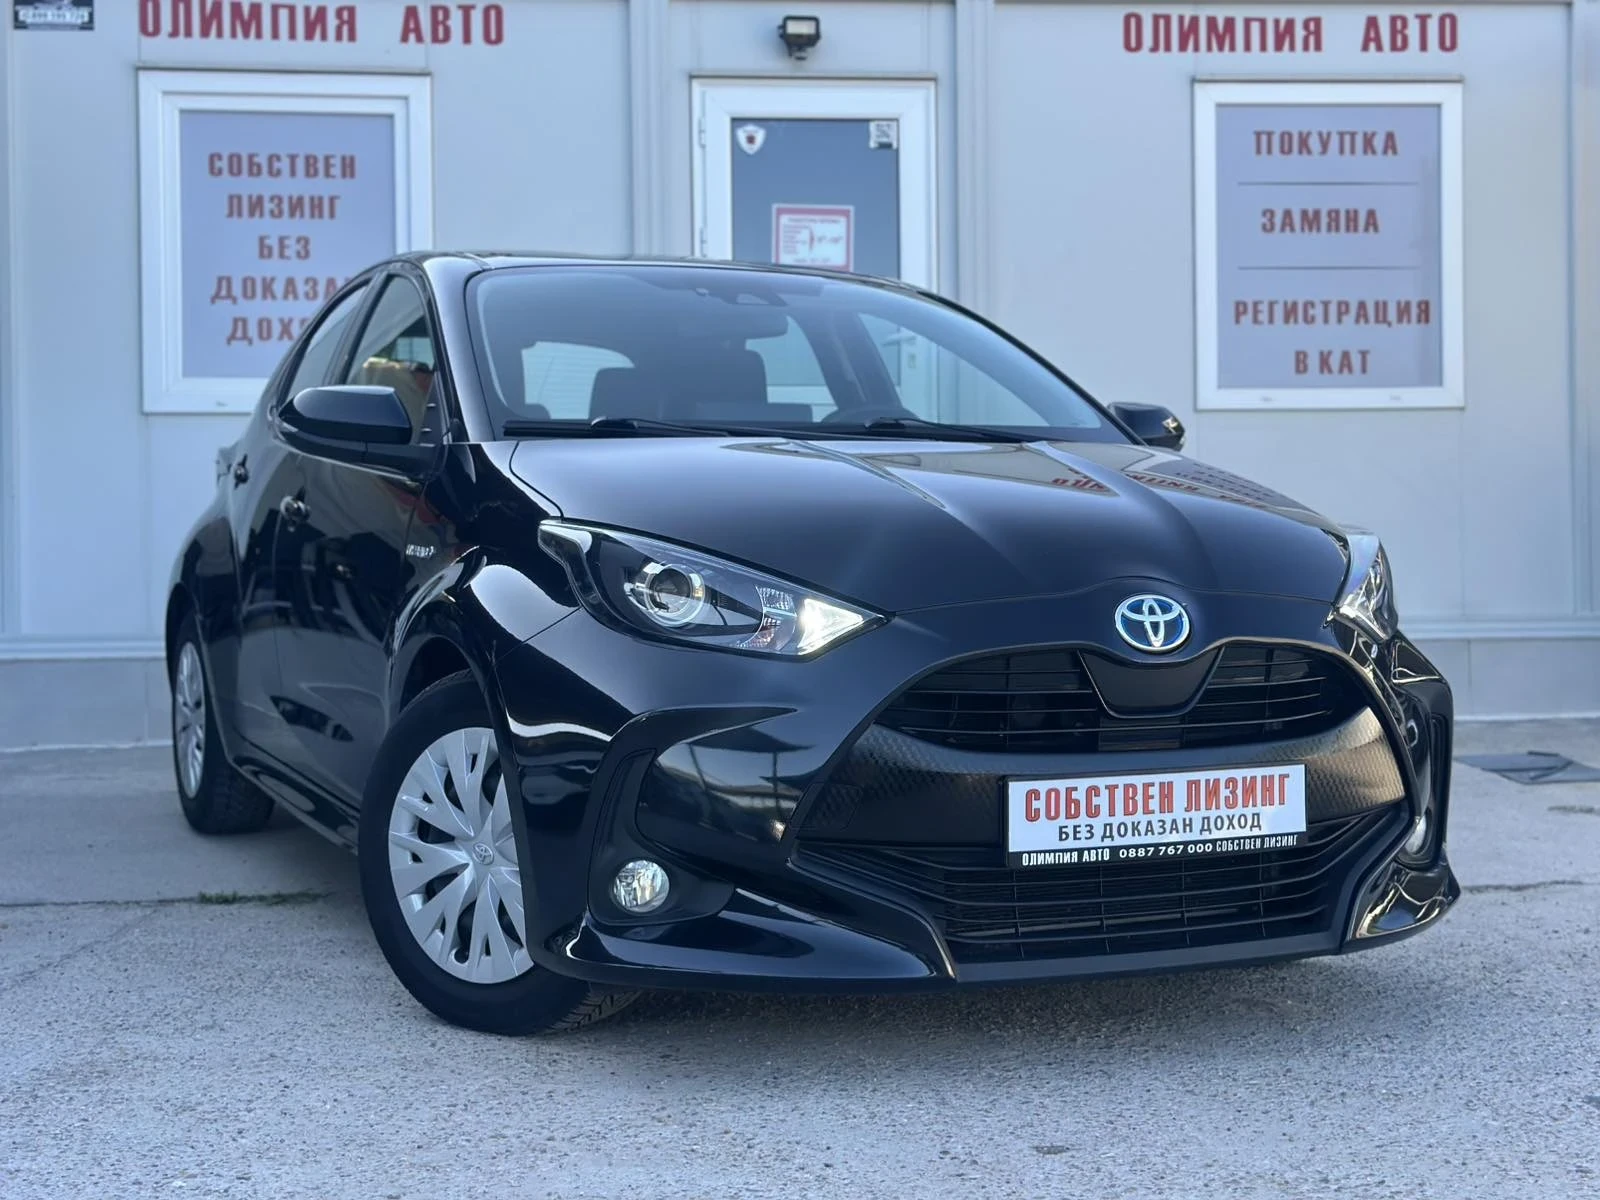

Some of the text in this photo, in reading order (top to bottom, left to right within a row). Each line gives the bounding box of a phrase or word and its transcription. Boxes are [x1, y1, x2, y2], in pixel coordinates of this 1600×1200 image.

[139, 0, 505, 46] ОЛИМПИЯ АВТО
[1123, 12, 1459, 54] ОЛИМПИЯ АВТО
[1253, 130, 1399, 157] ПОКУПКА
[208, 152, 358, 180] СОБСТВЕН
[226, 194, 341, 220] ЛИЗИНГ
[1260, 207, 1381, 234] ЗАМЯНА
[258, 235, 312, 261] БЕЗ
[209, 275, 351, 305] ДОКАЗА
[1233, 299, 1432, 328] РЕГИСТРАЦИЯ
[1294, 350, 1372, 375] В КАТ
[1024, 773, 1291, 823] СОБСТВЕН ЛИЗИНГ
[1058, 812, 1263, 842] БЕЗ ДОКАЗАН ДОХОД
[1021, 834, 1299, 866] ОЛИМПИЯ АВТО 0887 767 000 СОБСТВЕН ЛИЗИНГ
